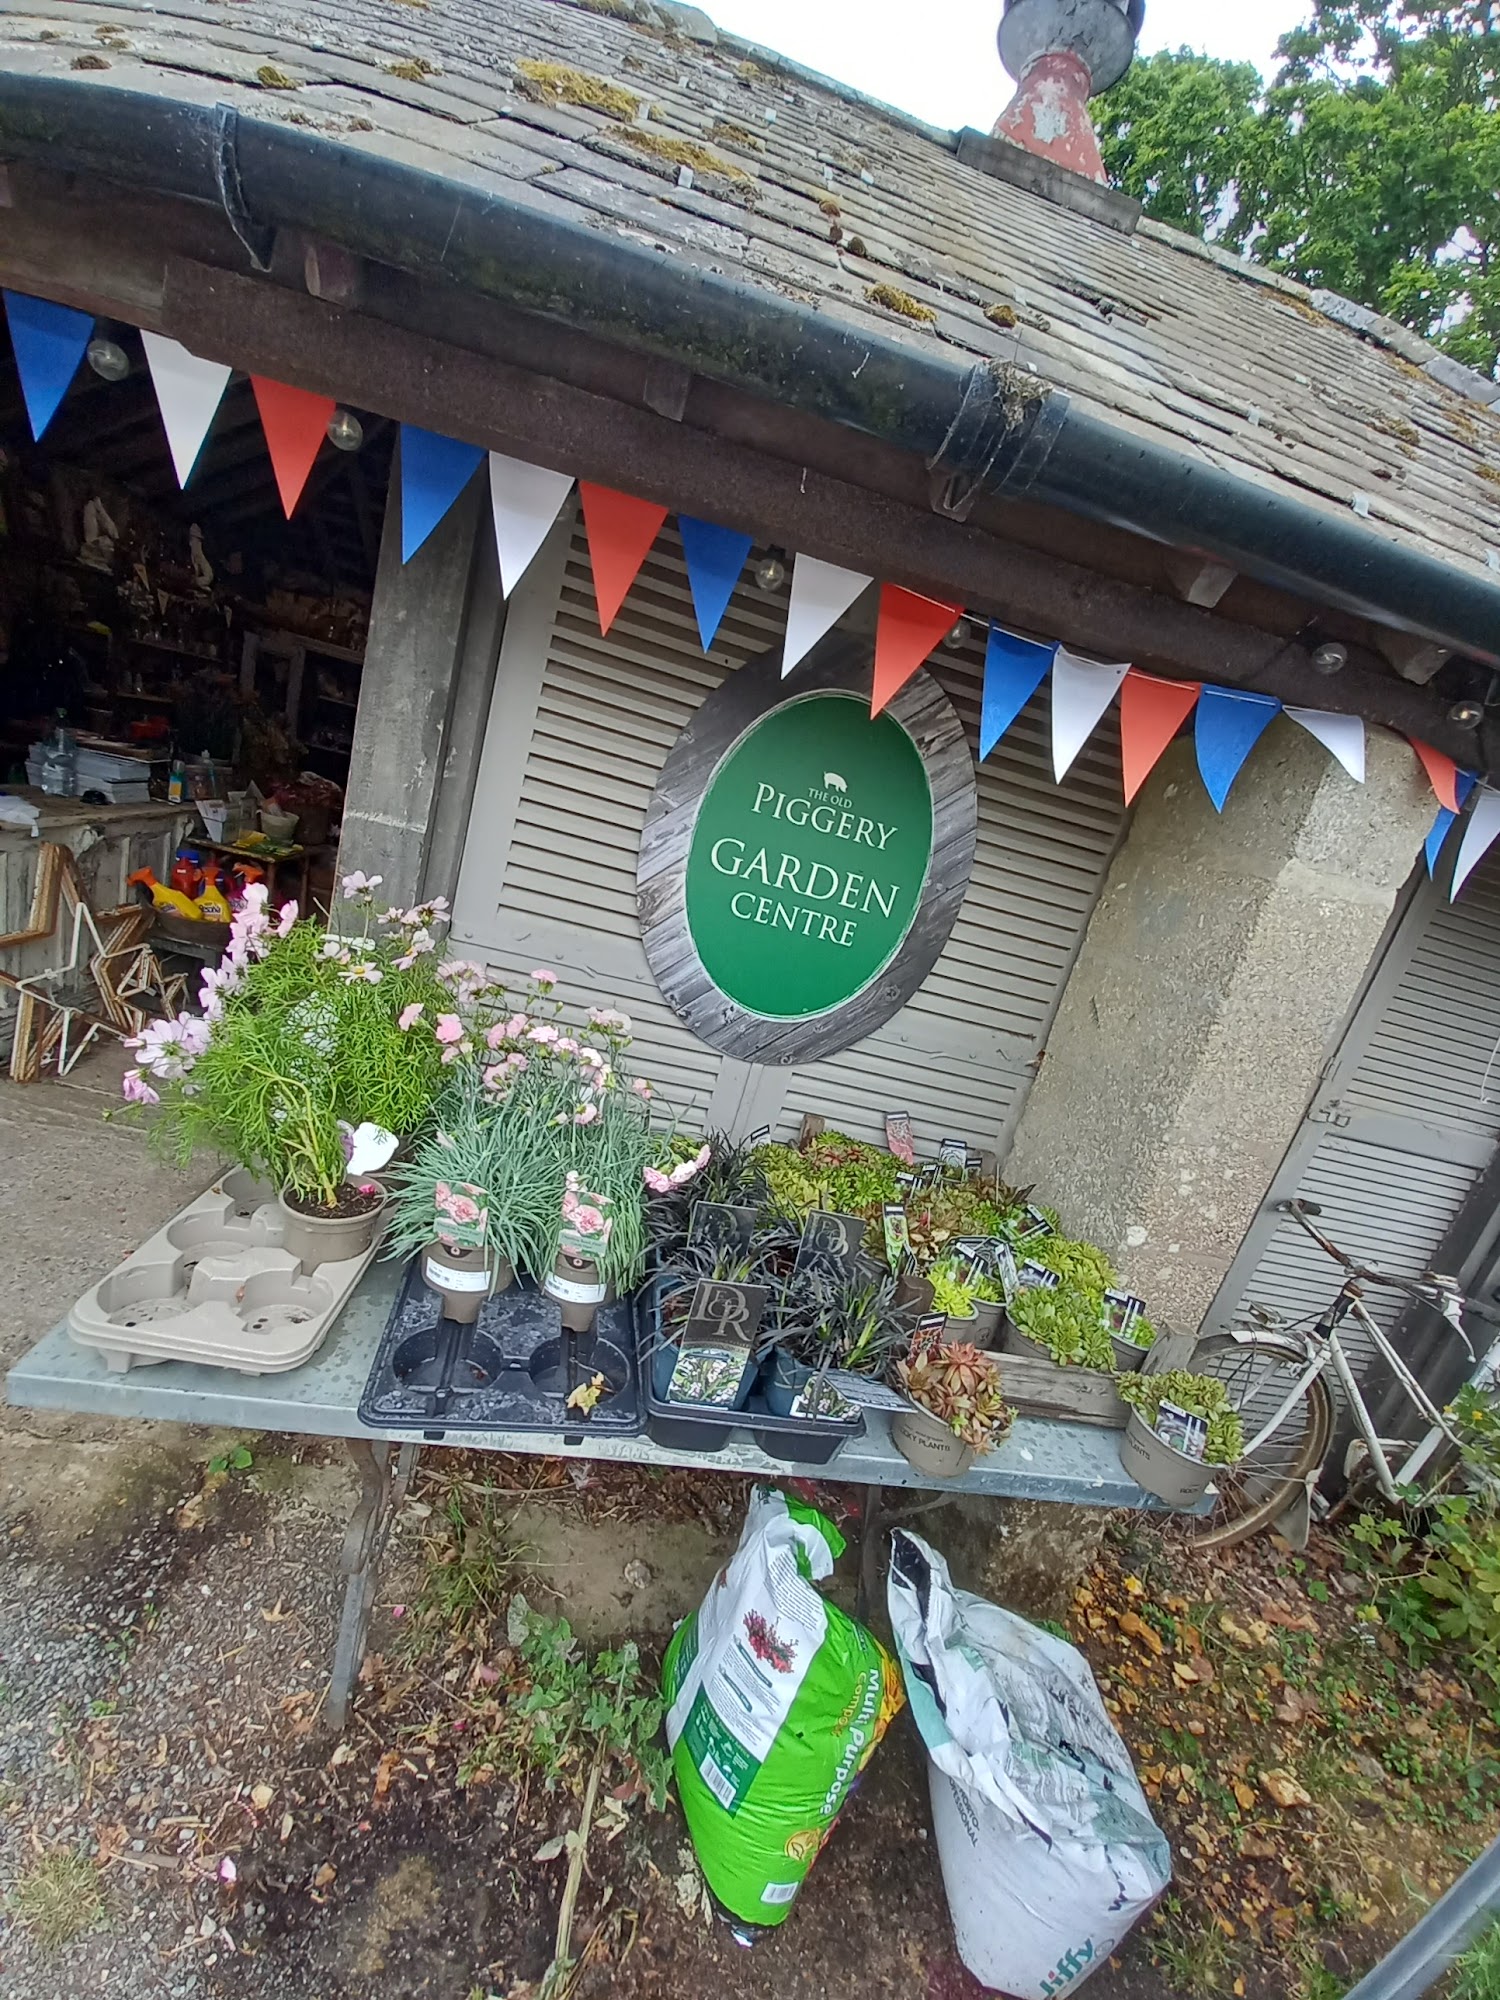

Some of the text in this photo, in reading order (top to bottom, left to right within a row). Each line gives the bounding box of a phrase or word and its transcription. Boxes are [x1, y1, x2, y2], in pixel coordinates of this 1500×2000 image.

[751, 781, 898, 851] PIGGERY
[808, 787, 852, 809] THE OLD
[710, 837, 900, 918] GARDEN
[730, 891, 857, 948] CENTRE
[819, 1668, 880, 1816] Multi Purpose
[1039, 1937, 1093, 1997] Jiffy
